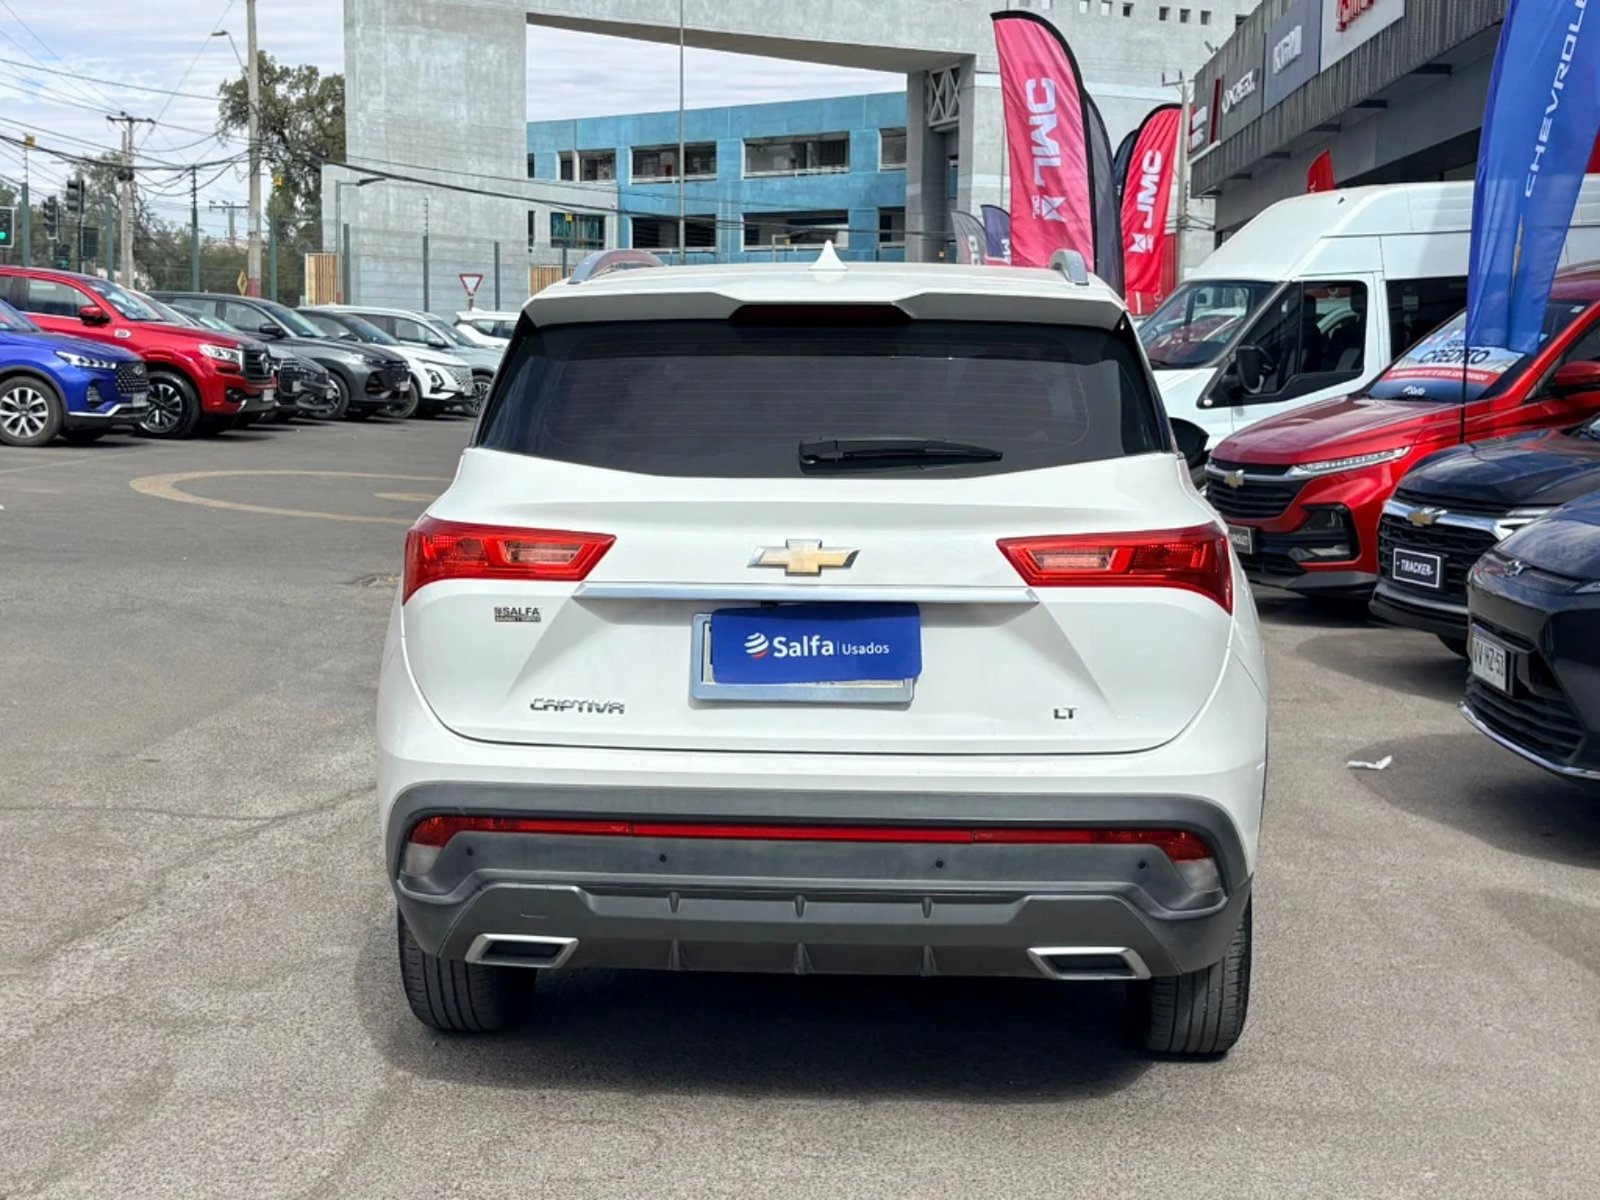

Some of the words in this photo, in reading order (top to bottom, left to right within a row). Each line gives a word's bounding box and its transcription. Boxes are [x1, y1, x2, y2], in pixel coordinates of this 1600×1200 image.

[1136, 150, 1164, 229] JMC
[773, 635, 834, 658] Salfa
[841, 642, 890, 655] Usados
[530, 698, 625, 714] CAPTIVA
[1053, 707, 1078, 720] LT
